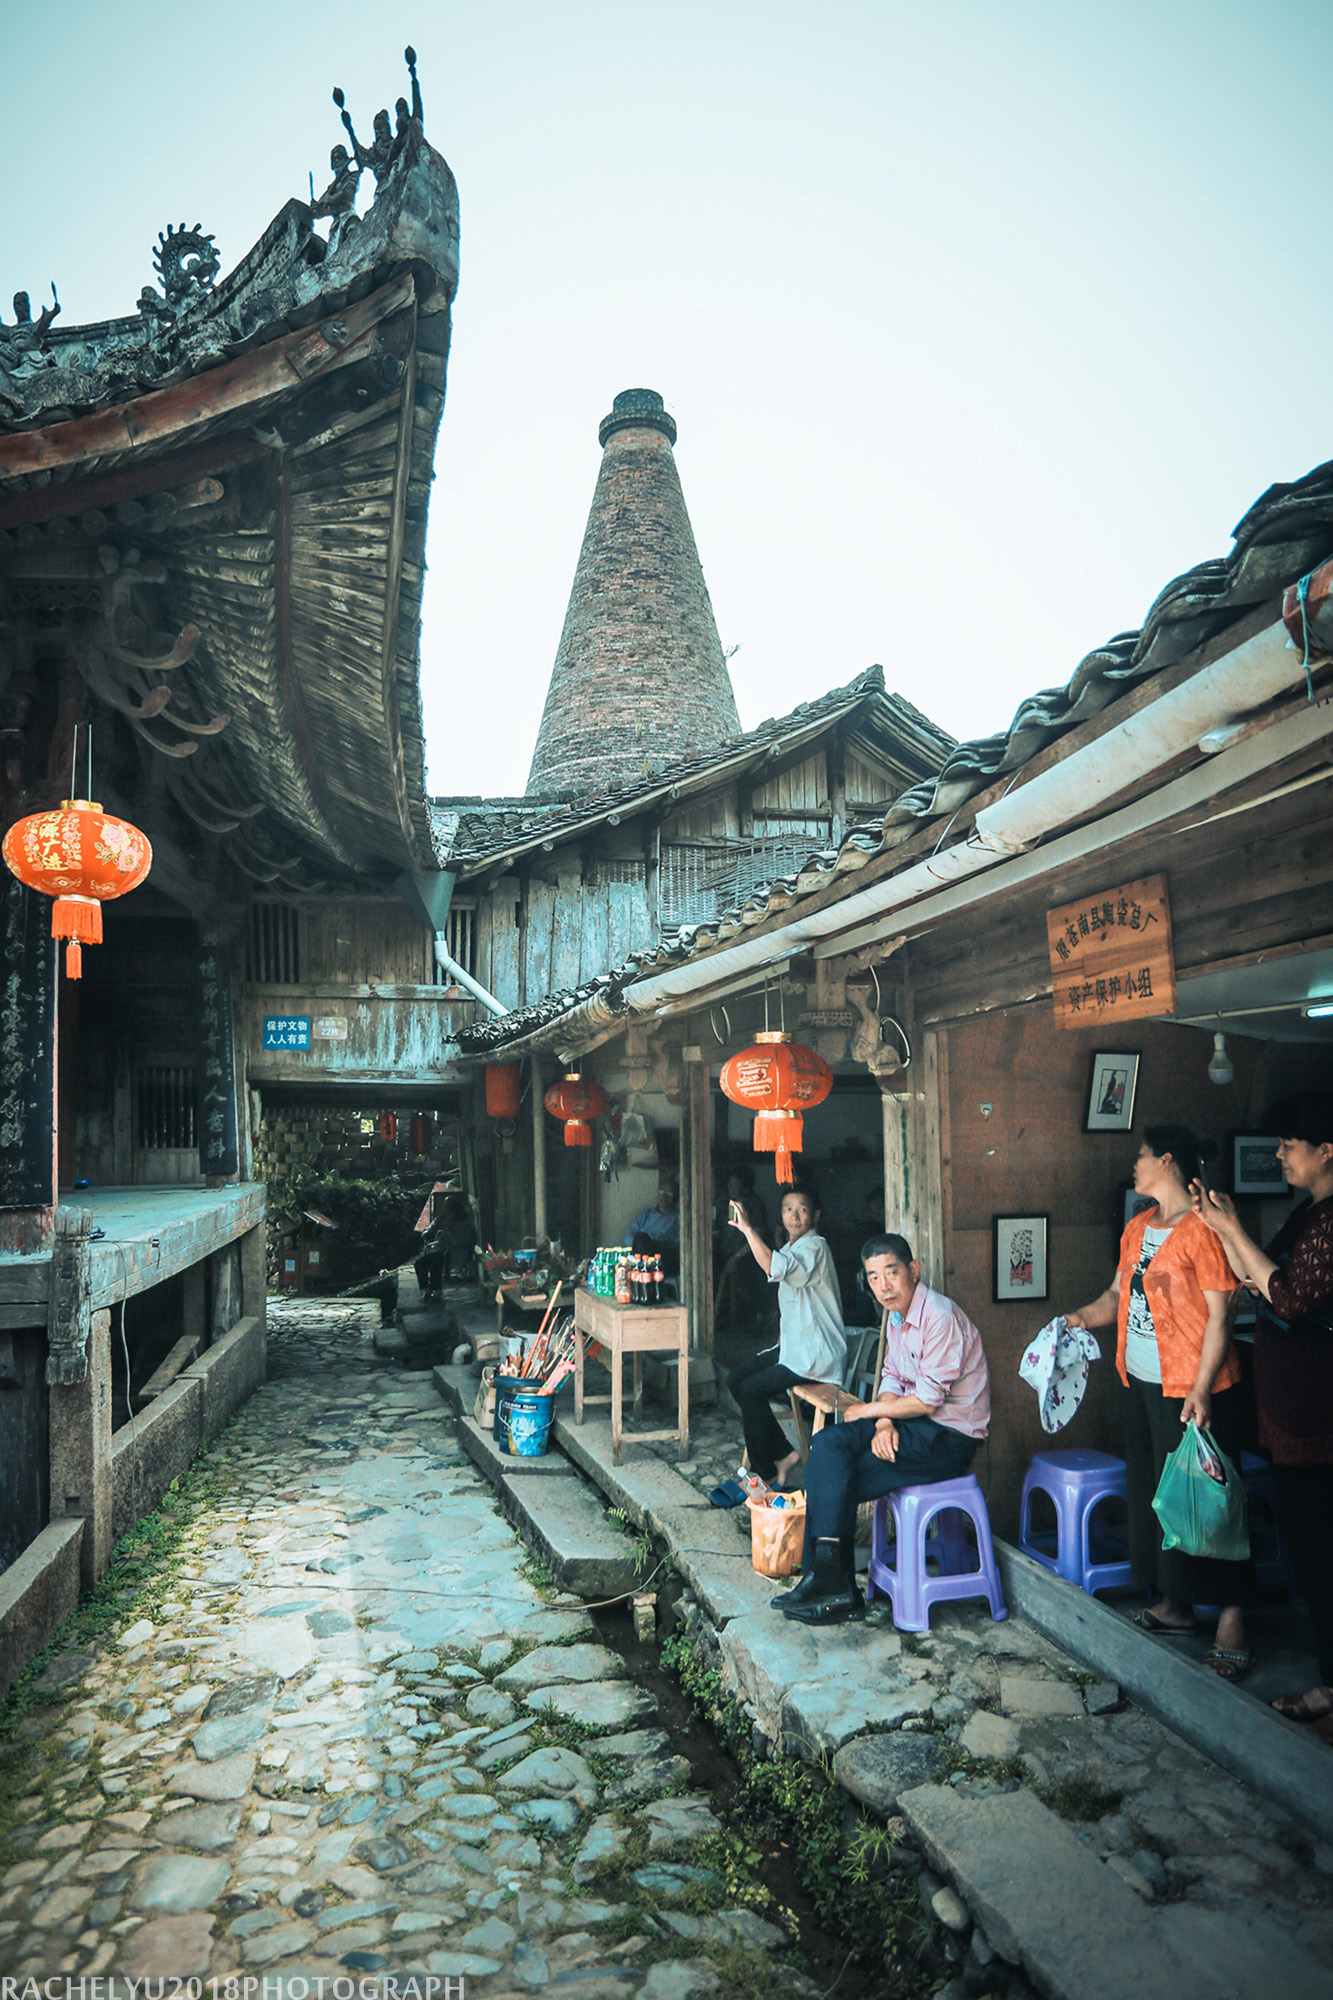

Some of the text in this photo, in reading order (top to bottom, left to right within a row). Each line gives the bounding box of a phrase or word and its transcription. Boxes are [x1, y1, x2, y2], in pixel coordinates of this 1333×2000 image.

[1068, 967, 1154, 1013] 资产保护小组
[267, 1020, 308, 1031] 保护文物
[267, 1034, 308, 1045] 人人有责
